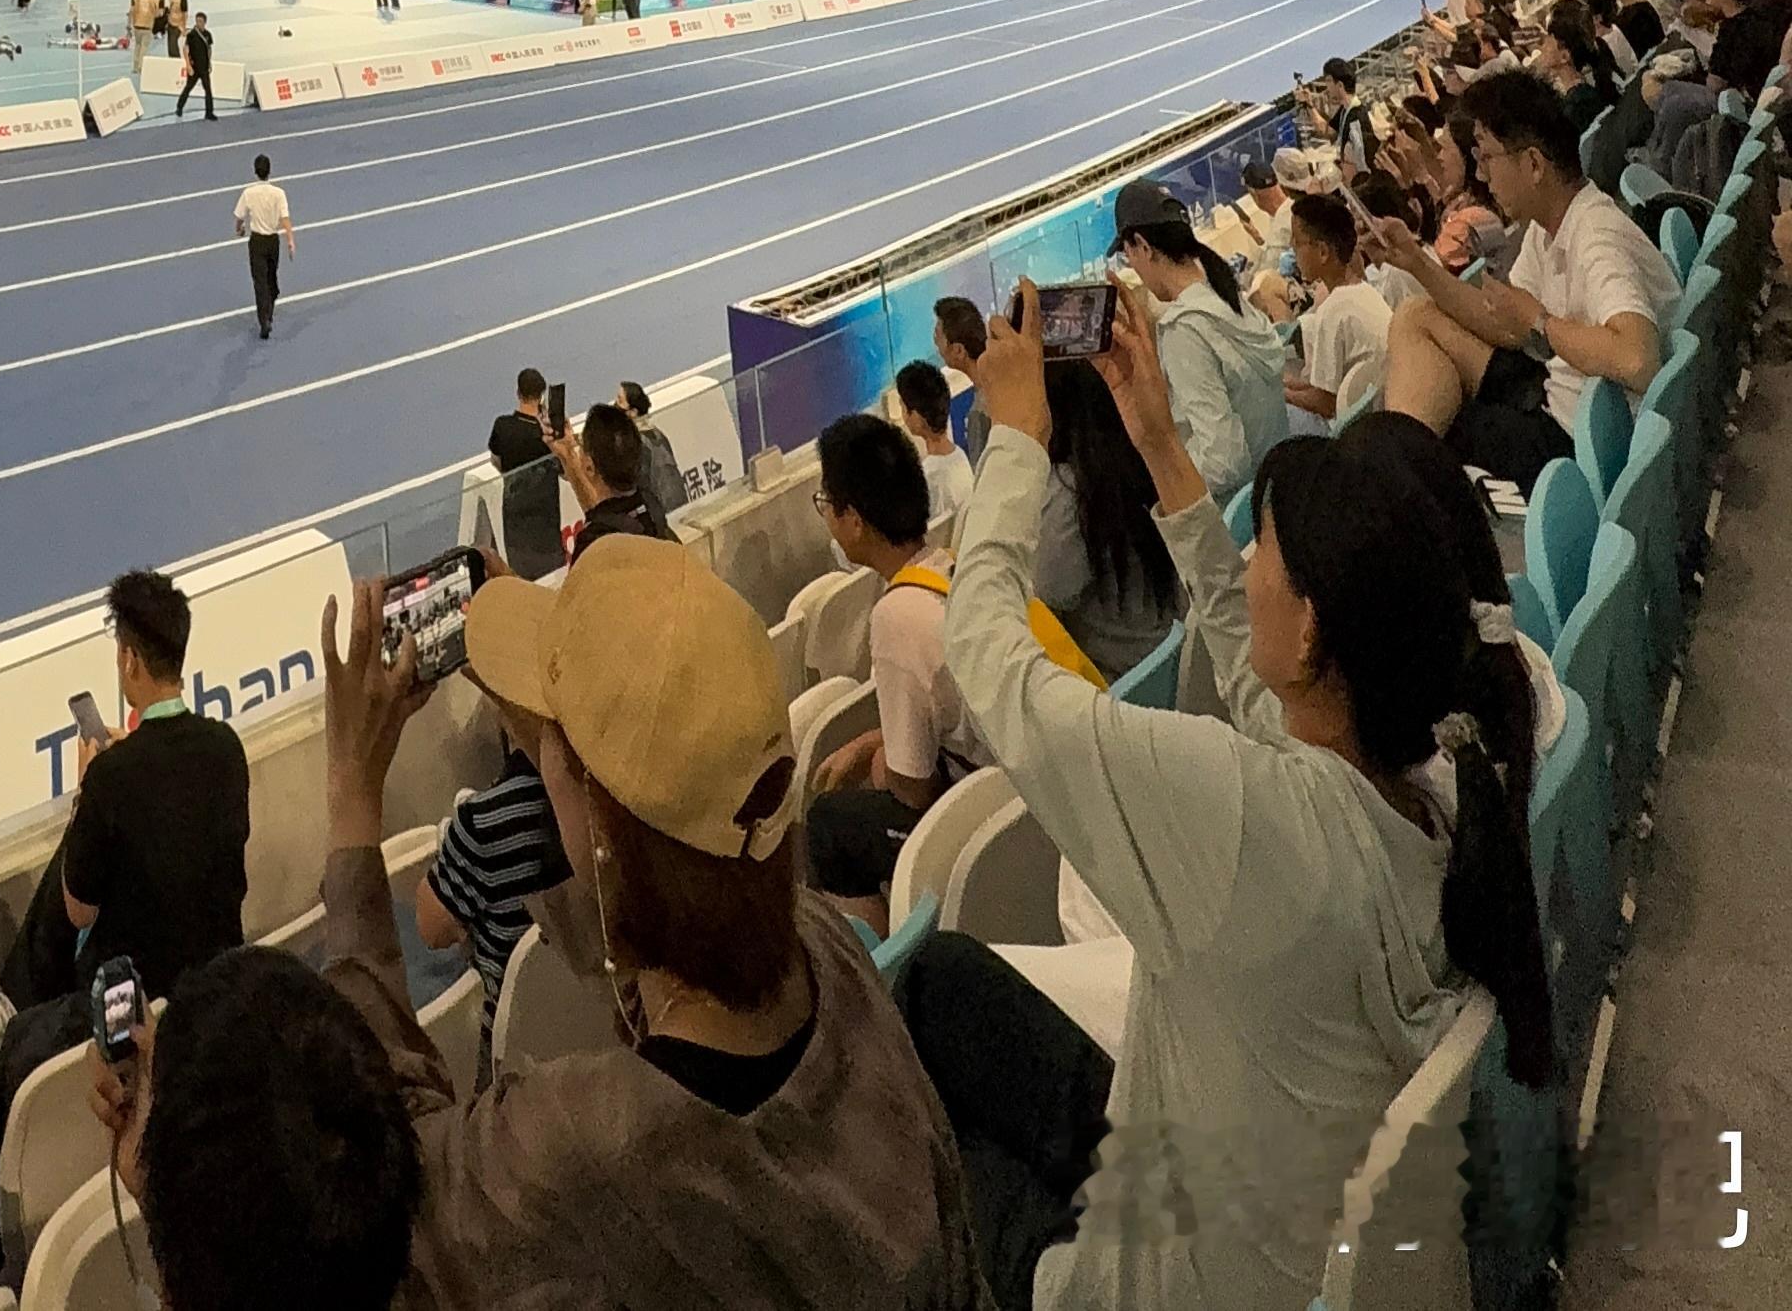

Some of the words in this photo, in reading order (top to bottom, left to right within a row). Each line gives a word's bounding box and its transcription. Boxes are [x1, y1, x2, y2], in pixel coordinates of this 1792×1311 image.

[13, 117, 73, 135] 中国人民保险
